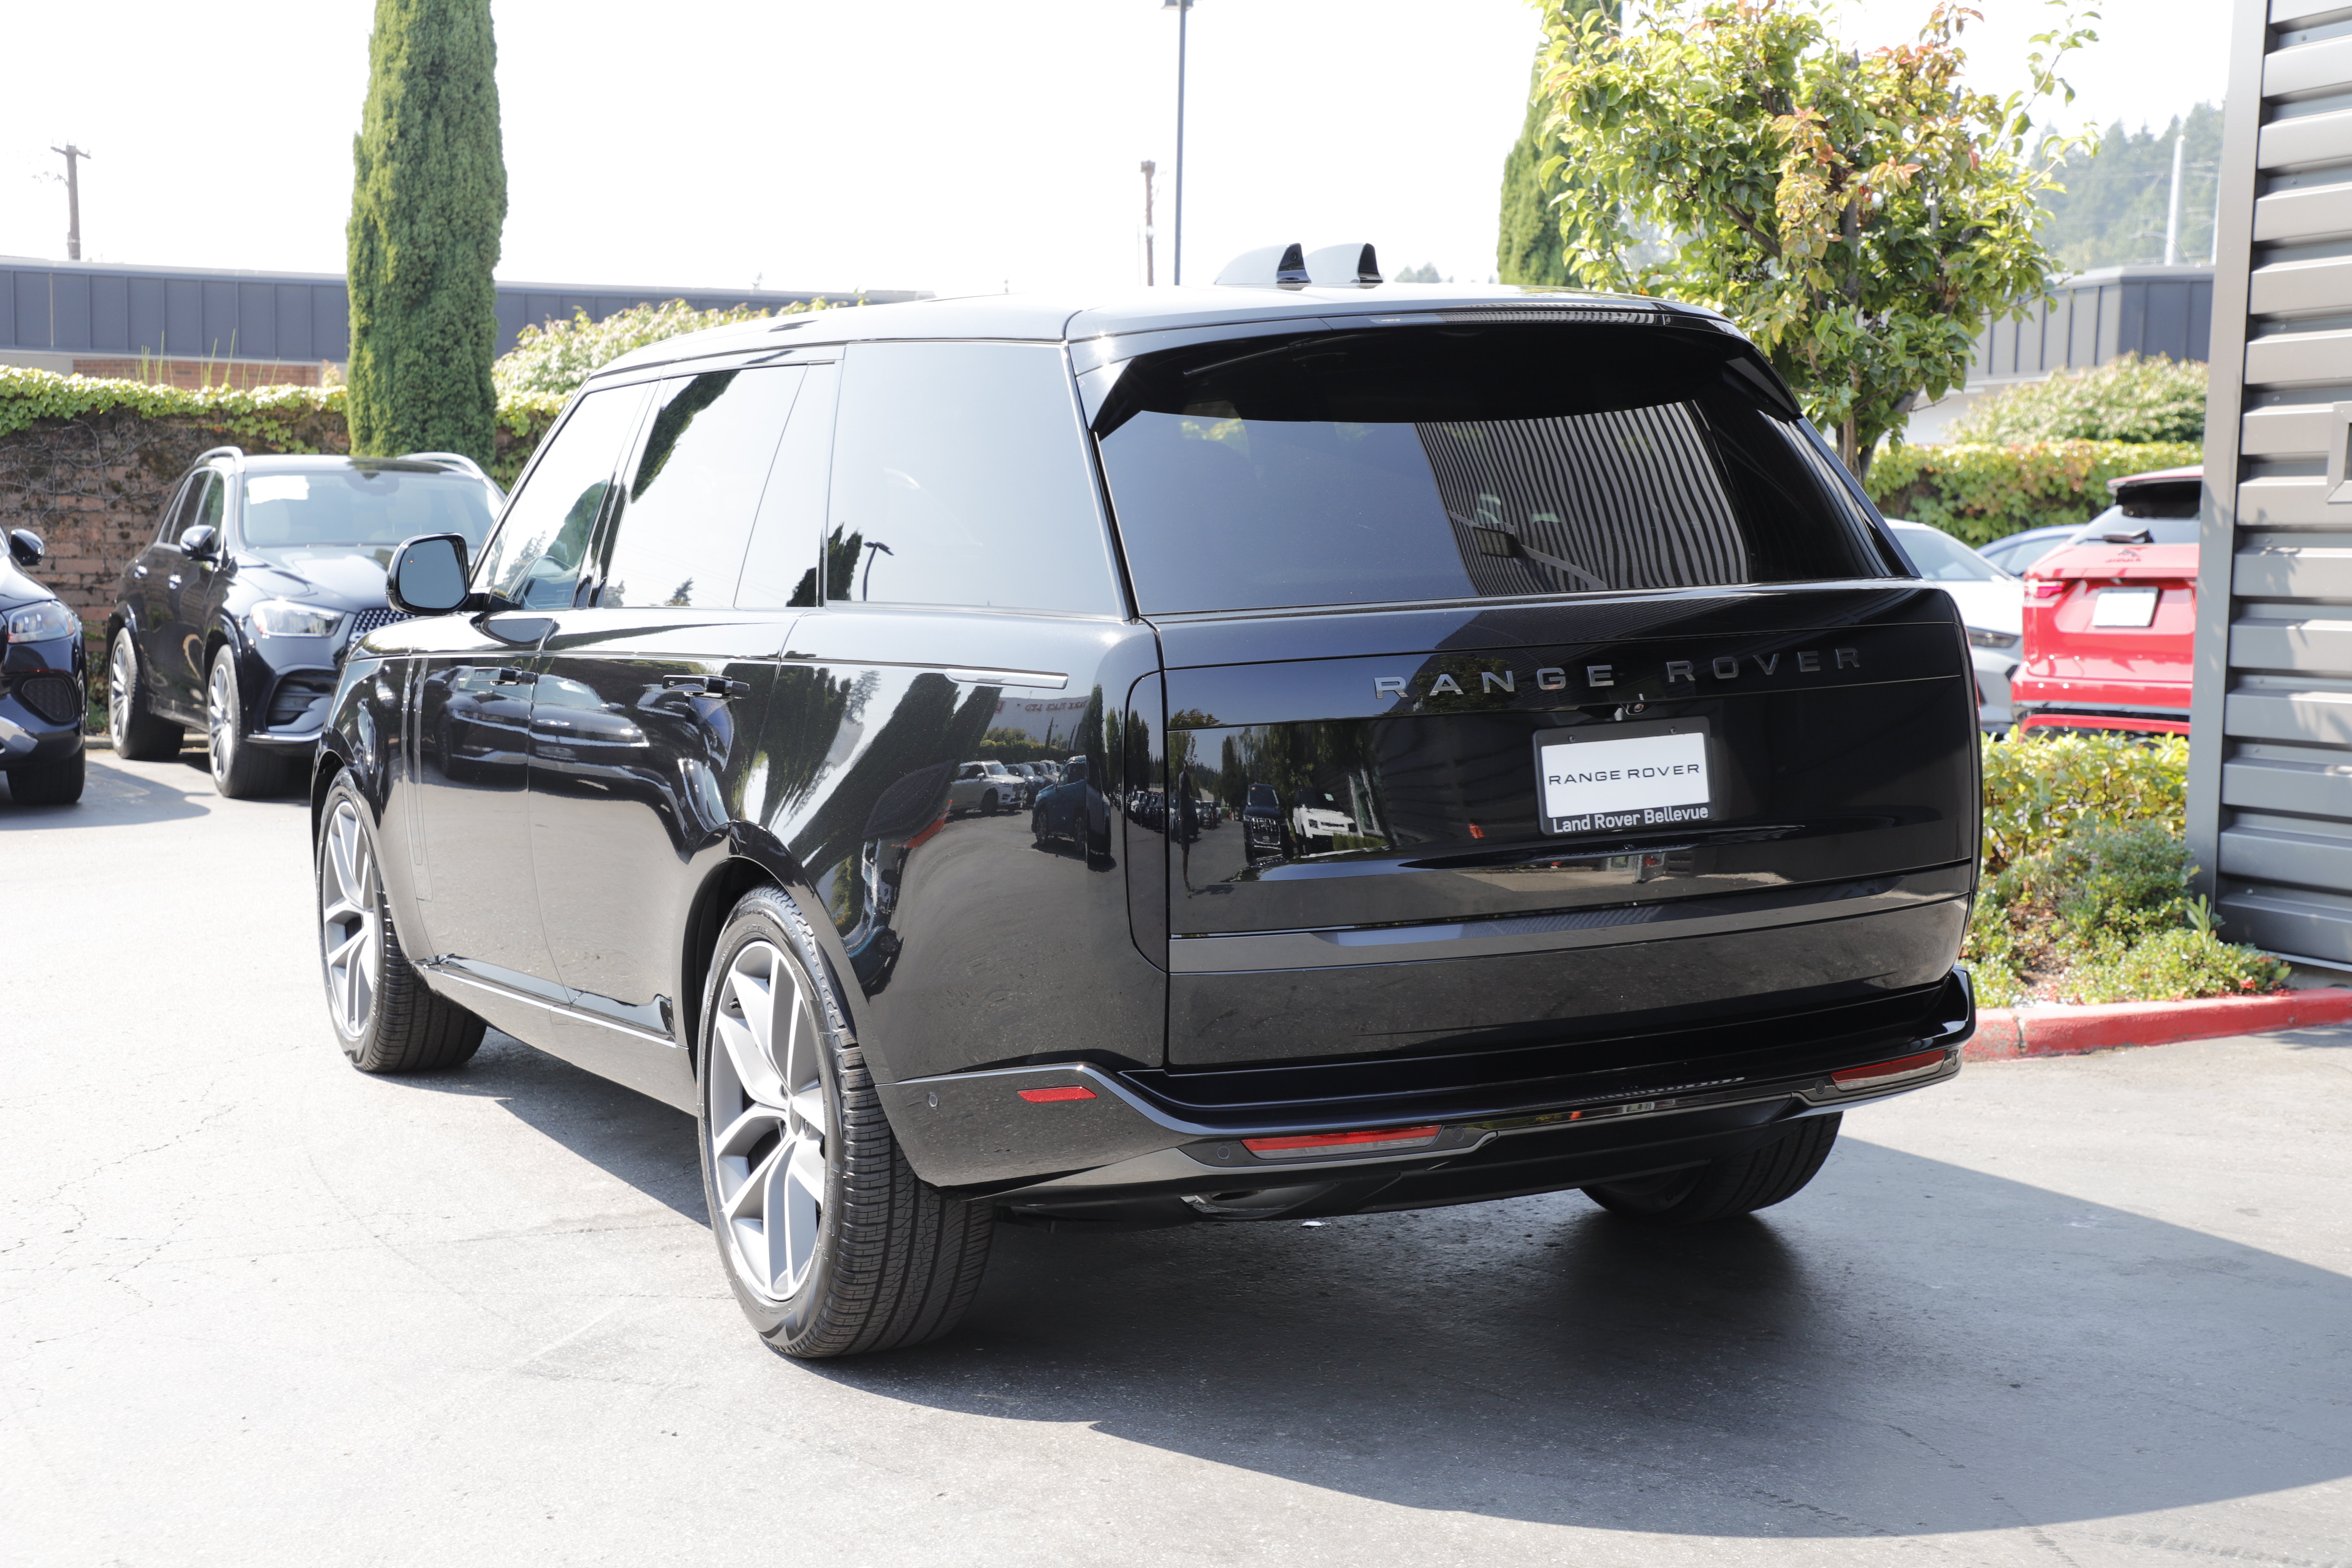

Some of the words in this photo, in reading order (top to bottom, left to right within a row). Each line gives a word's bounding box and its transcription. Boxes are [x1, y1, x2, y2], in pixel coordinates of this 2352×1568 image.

[1374, 665, 1614, 699] RANGE
[1666, 648, 1860, 682] ROVER
[1549, 770, 1621, 785] RANGE
[1628, 764, 1699, 779] ROVER
[1553, 815, 1590, 833] Land
[1594, 812, 1641, 829] Rover
[1644, 806, 1709, 824] Bellevue
